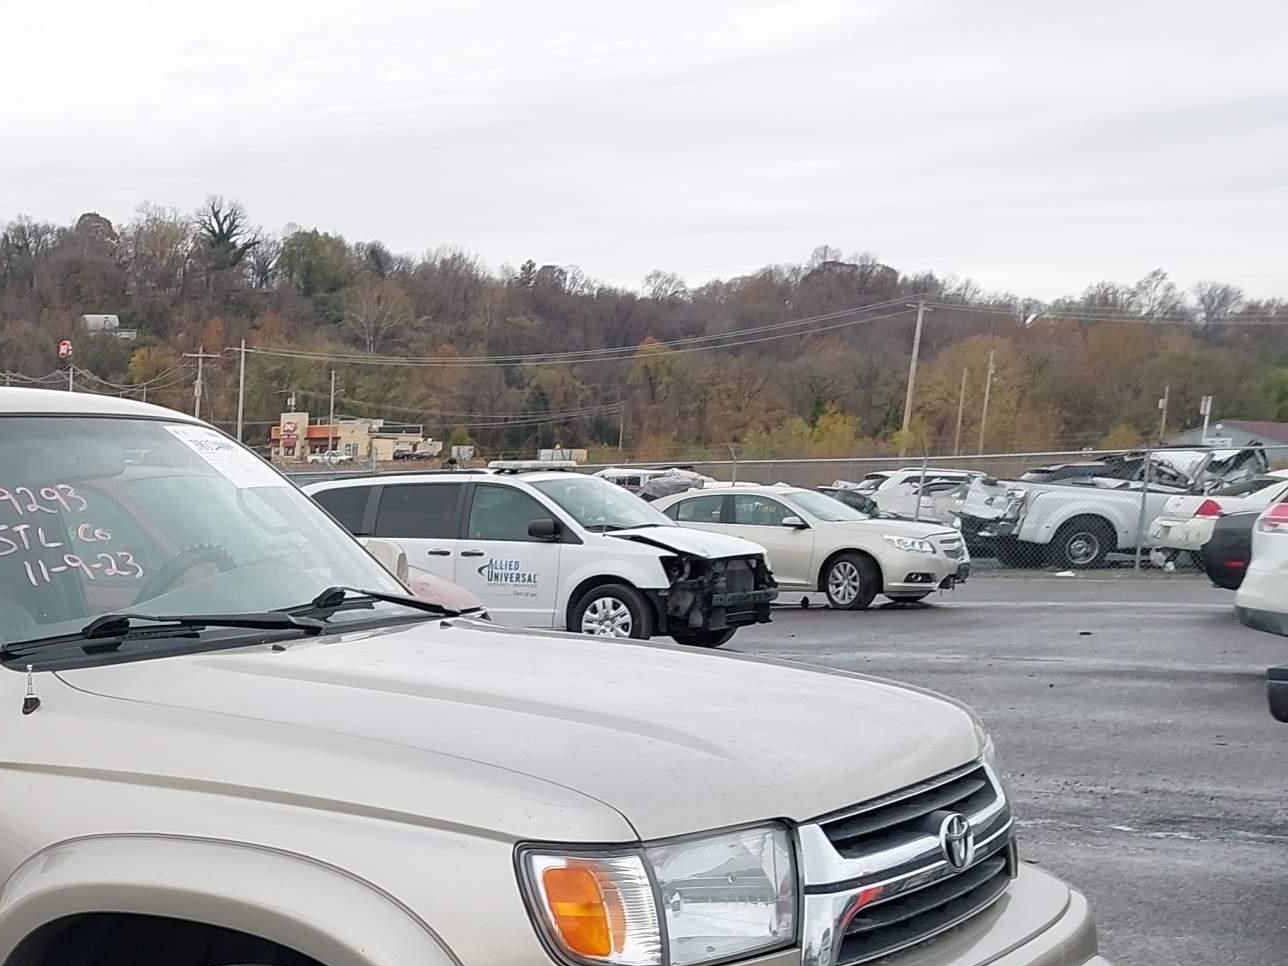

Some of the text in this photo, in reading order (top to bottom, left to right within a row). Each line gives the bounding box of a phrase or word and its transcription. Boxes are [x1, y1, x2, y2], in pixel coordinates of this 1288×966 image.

[23, 551, 144, 587] 11-9-23
[487, 558, 520, 571] ALLIED
[487, 570, 538, 584] UNIVERSAL
